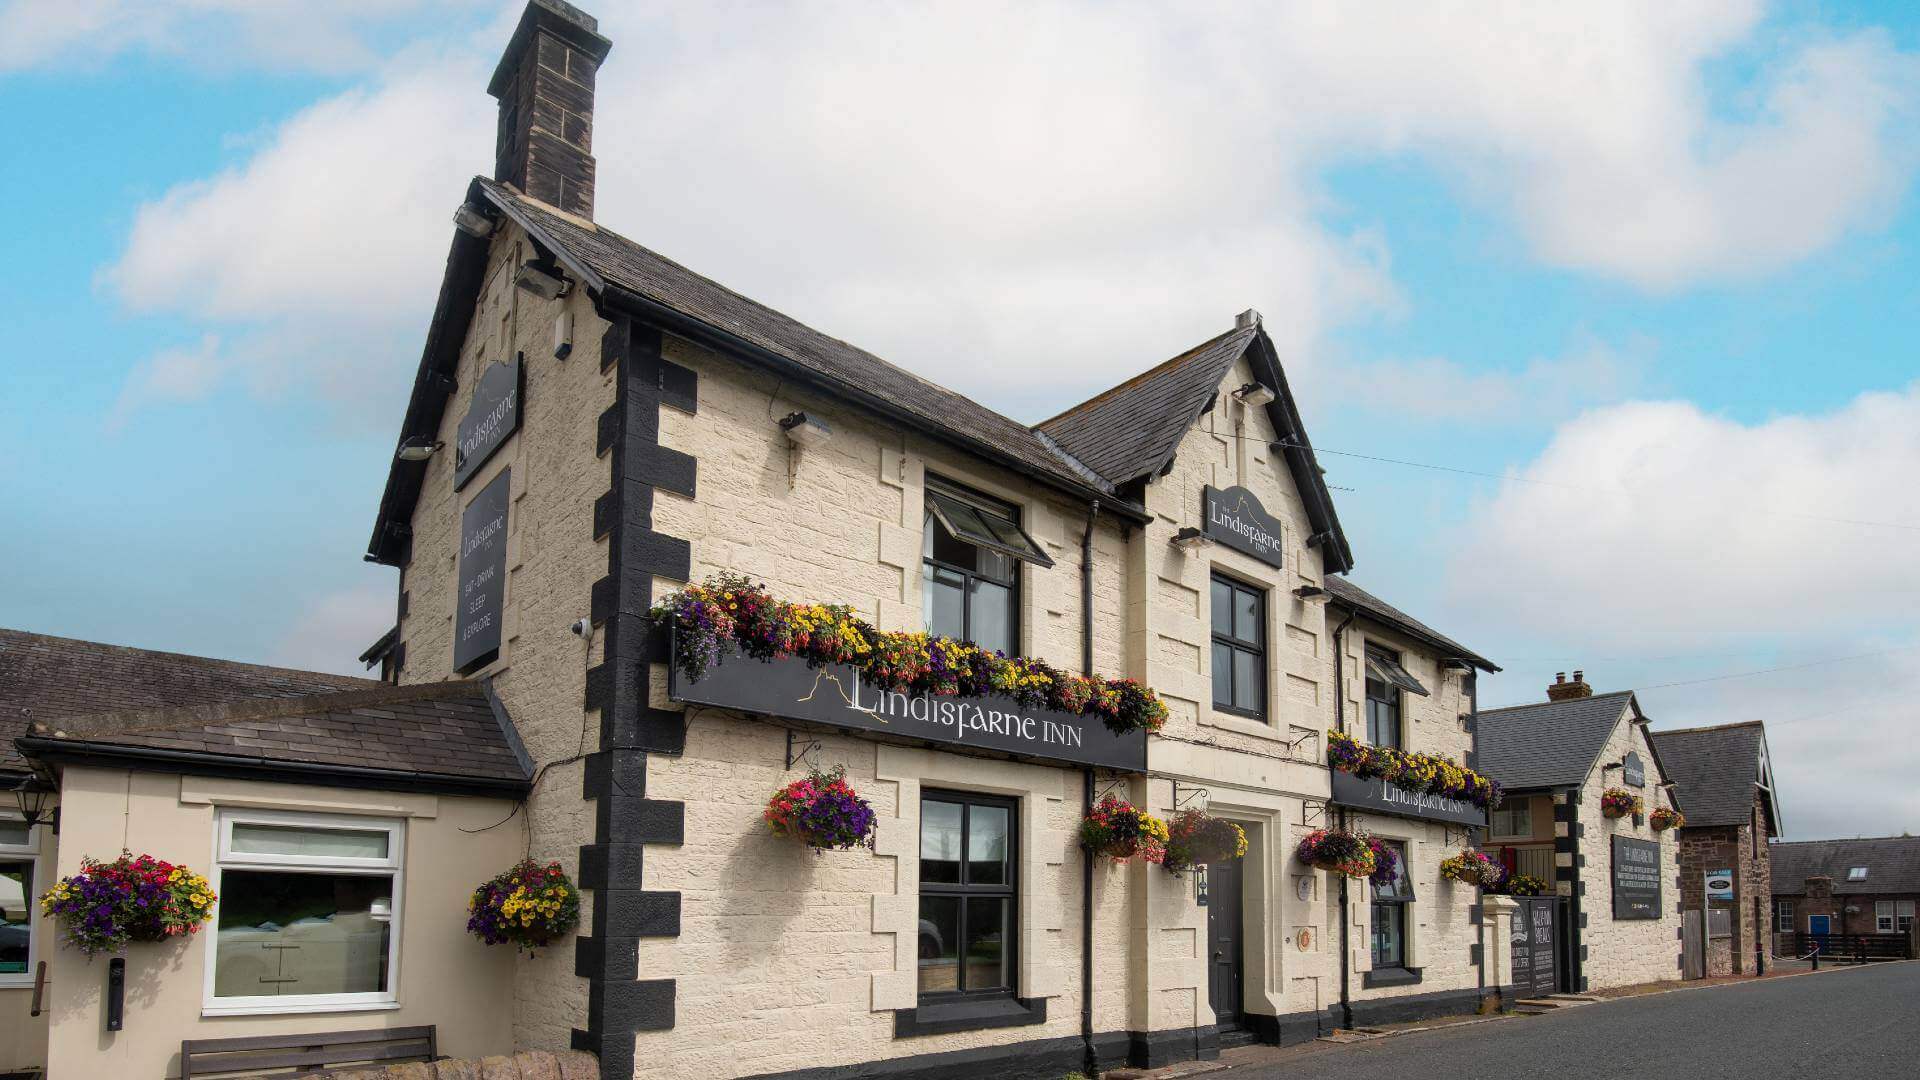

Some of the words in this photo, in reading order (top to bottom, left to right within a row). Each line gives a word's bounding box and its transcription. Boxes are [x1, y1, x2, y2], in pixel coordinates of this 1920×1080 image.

[1208, 499, 1280, 552] Lindisfarne
[469, 593, 486, 614] SLEEP
[1043, 721, 1083, 748] INN
